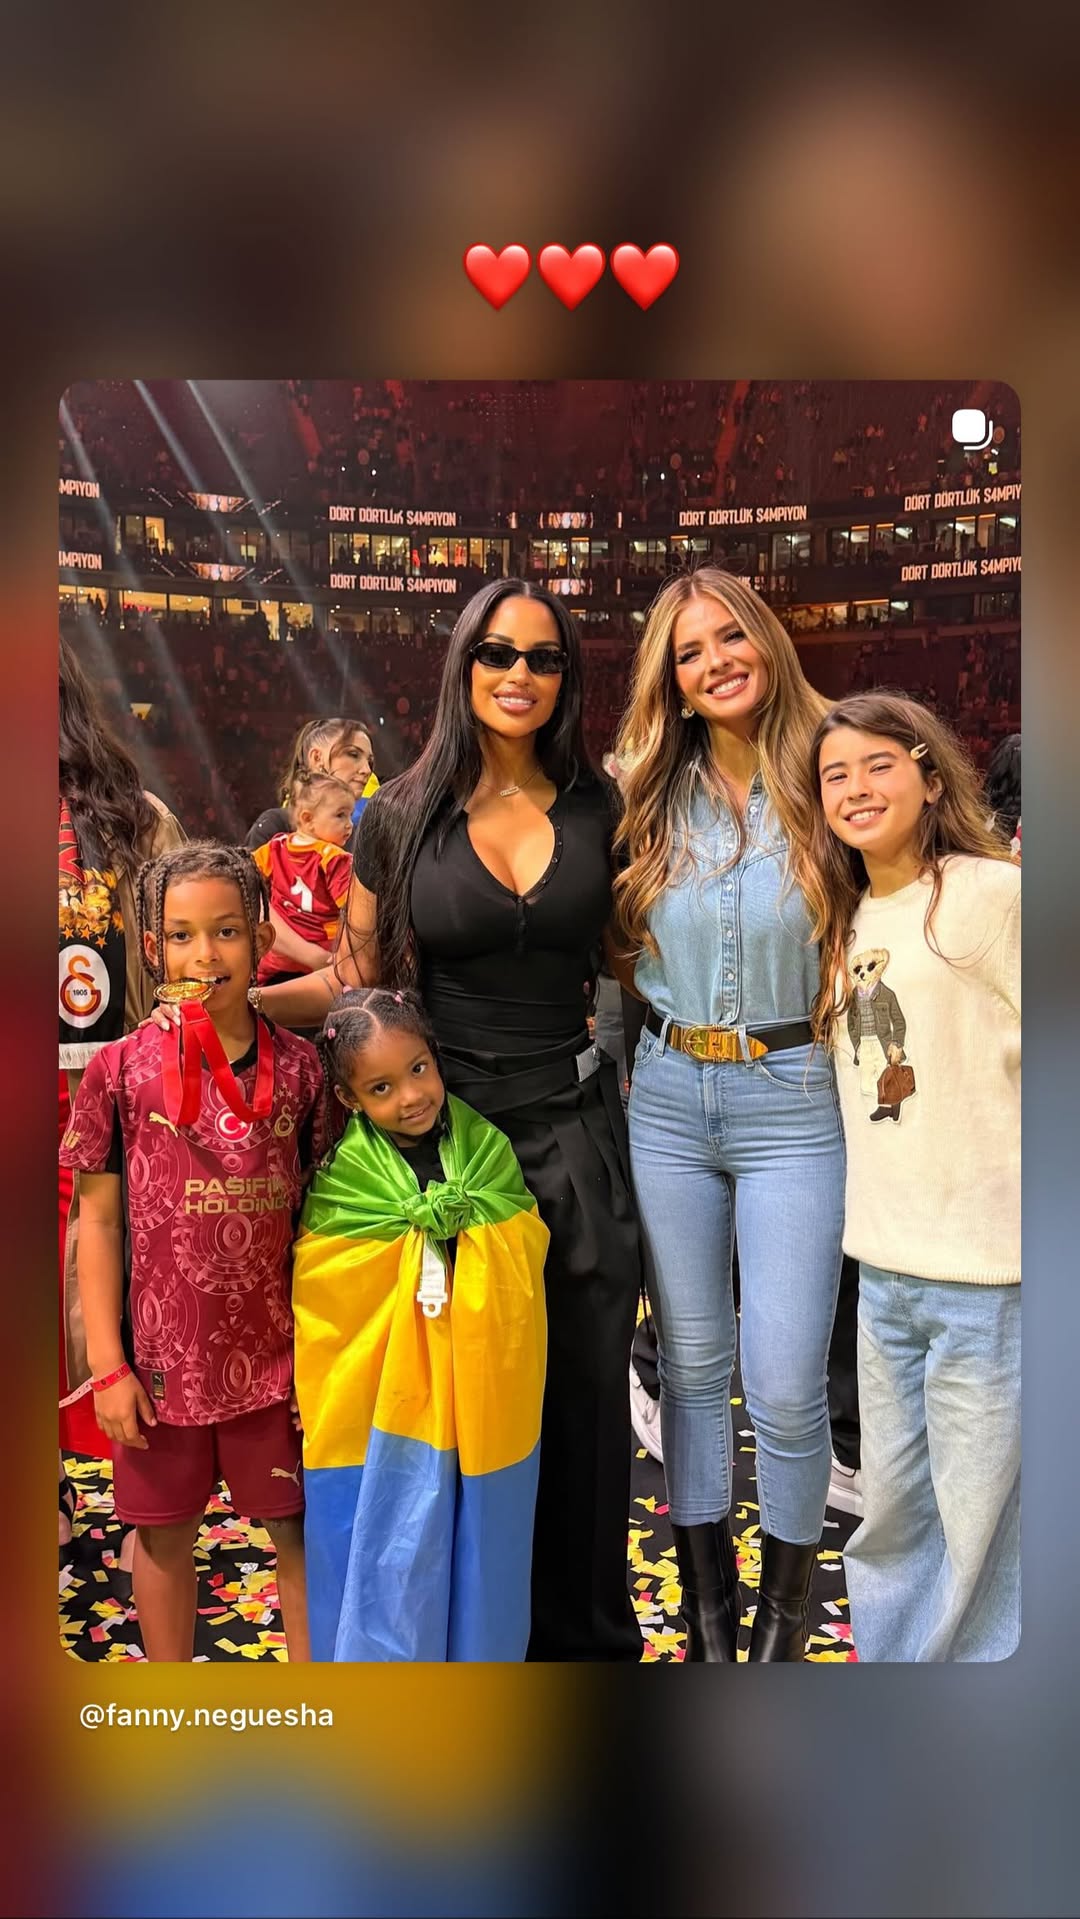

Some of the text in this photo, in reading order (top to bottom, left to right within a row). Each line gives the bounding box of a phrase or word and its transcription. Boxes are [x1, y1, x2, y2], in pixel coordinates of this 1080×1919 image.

[59, 478, 100, 498] MPİYON
[905, 494, 931, 511] DÖRT
[935, 488, 980, 508] DÖRTLÜK
[329, 506, 355, 521] DÖRT
[359, 507, 403, 524] DÖRTLÜK
[679, 511, 706, 526] DÖRT
[709, 508, 753, 525] DÖRTLÜK
[902, 565, 928, 581] DÖRT
[931, 560, 977, 578] DÖRTLÜK
[330, 574, 356, 589] DÖRT
[360, 575, 404, 591] DÖRTLÜK
